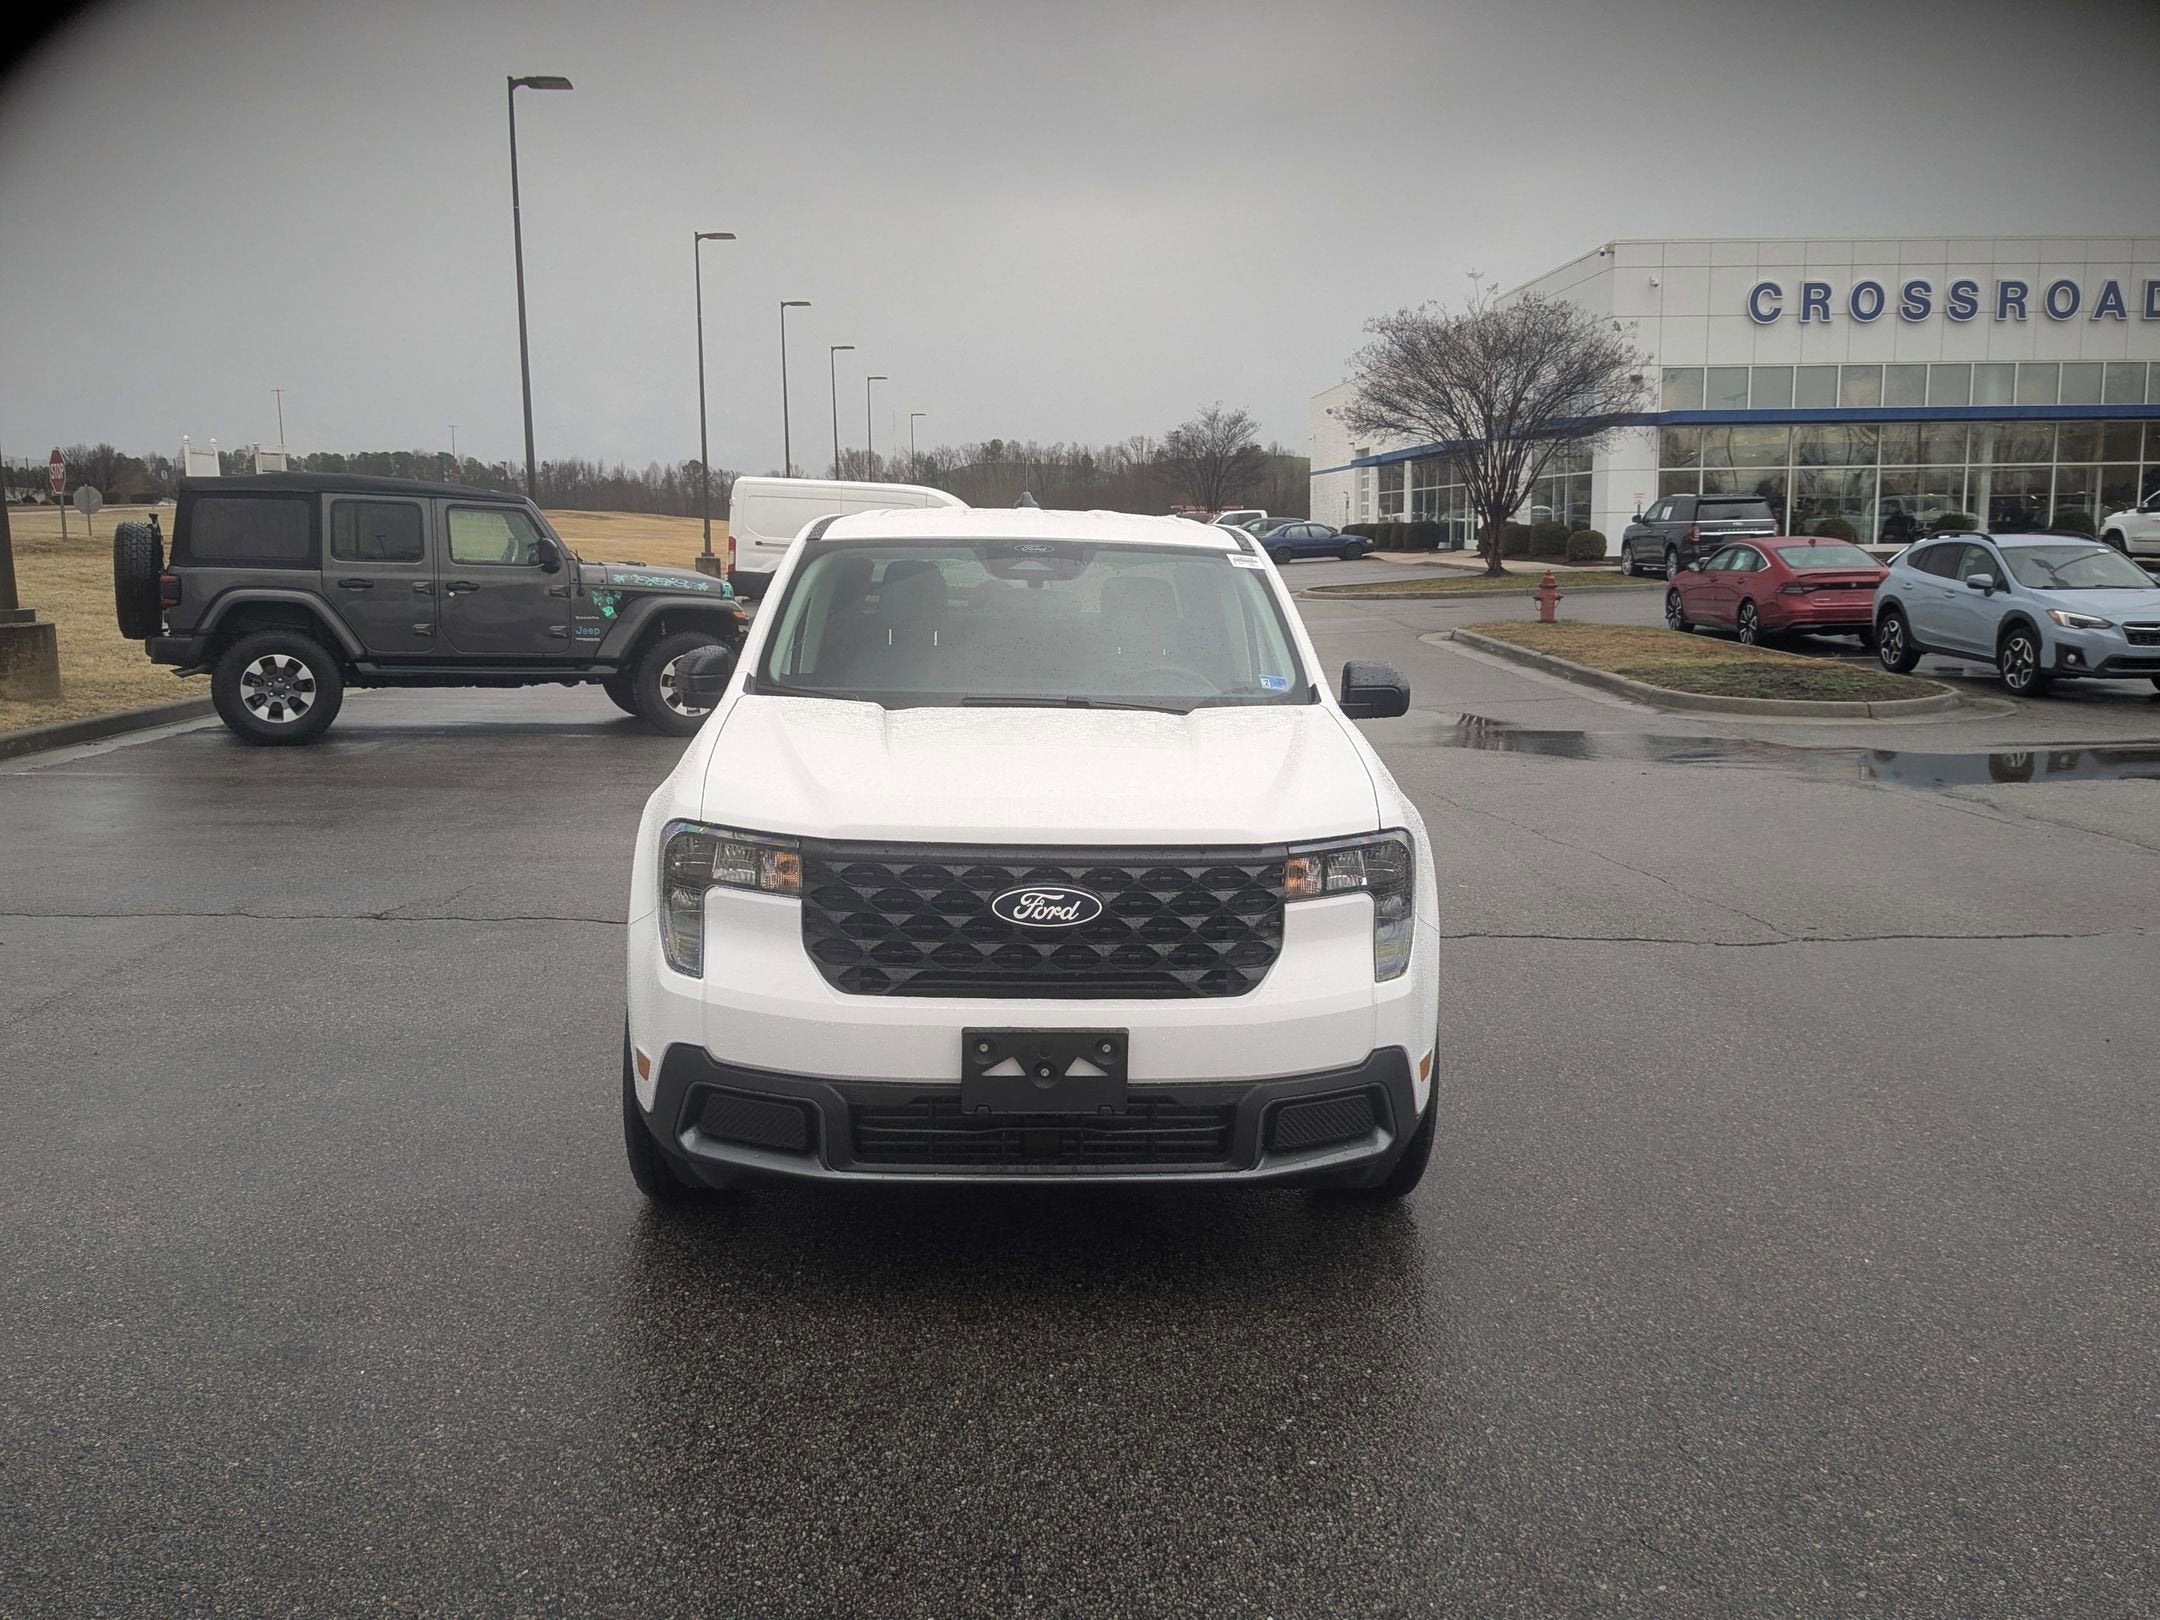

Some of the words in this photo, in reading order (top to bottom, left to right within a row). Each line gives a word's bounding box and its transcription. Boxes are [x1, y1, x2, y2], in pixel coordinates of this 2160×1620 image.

[50, 463, 64, 480] STOP
[575, 626, 600, 636] Jeep
[1013, 892, 1081, 921] Ford
